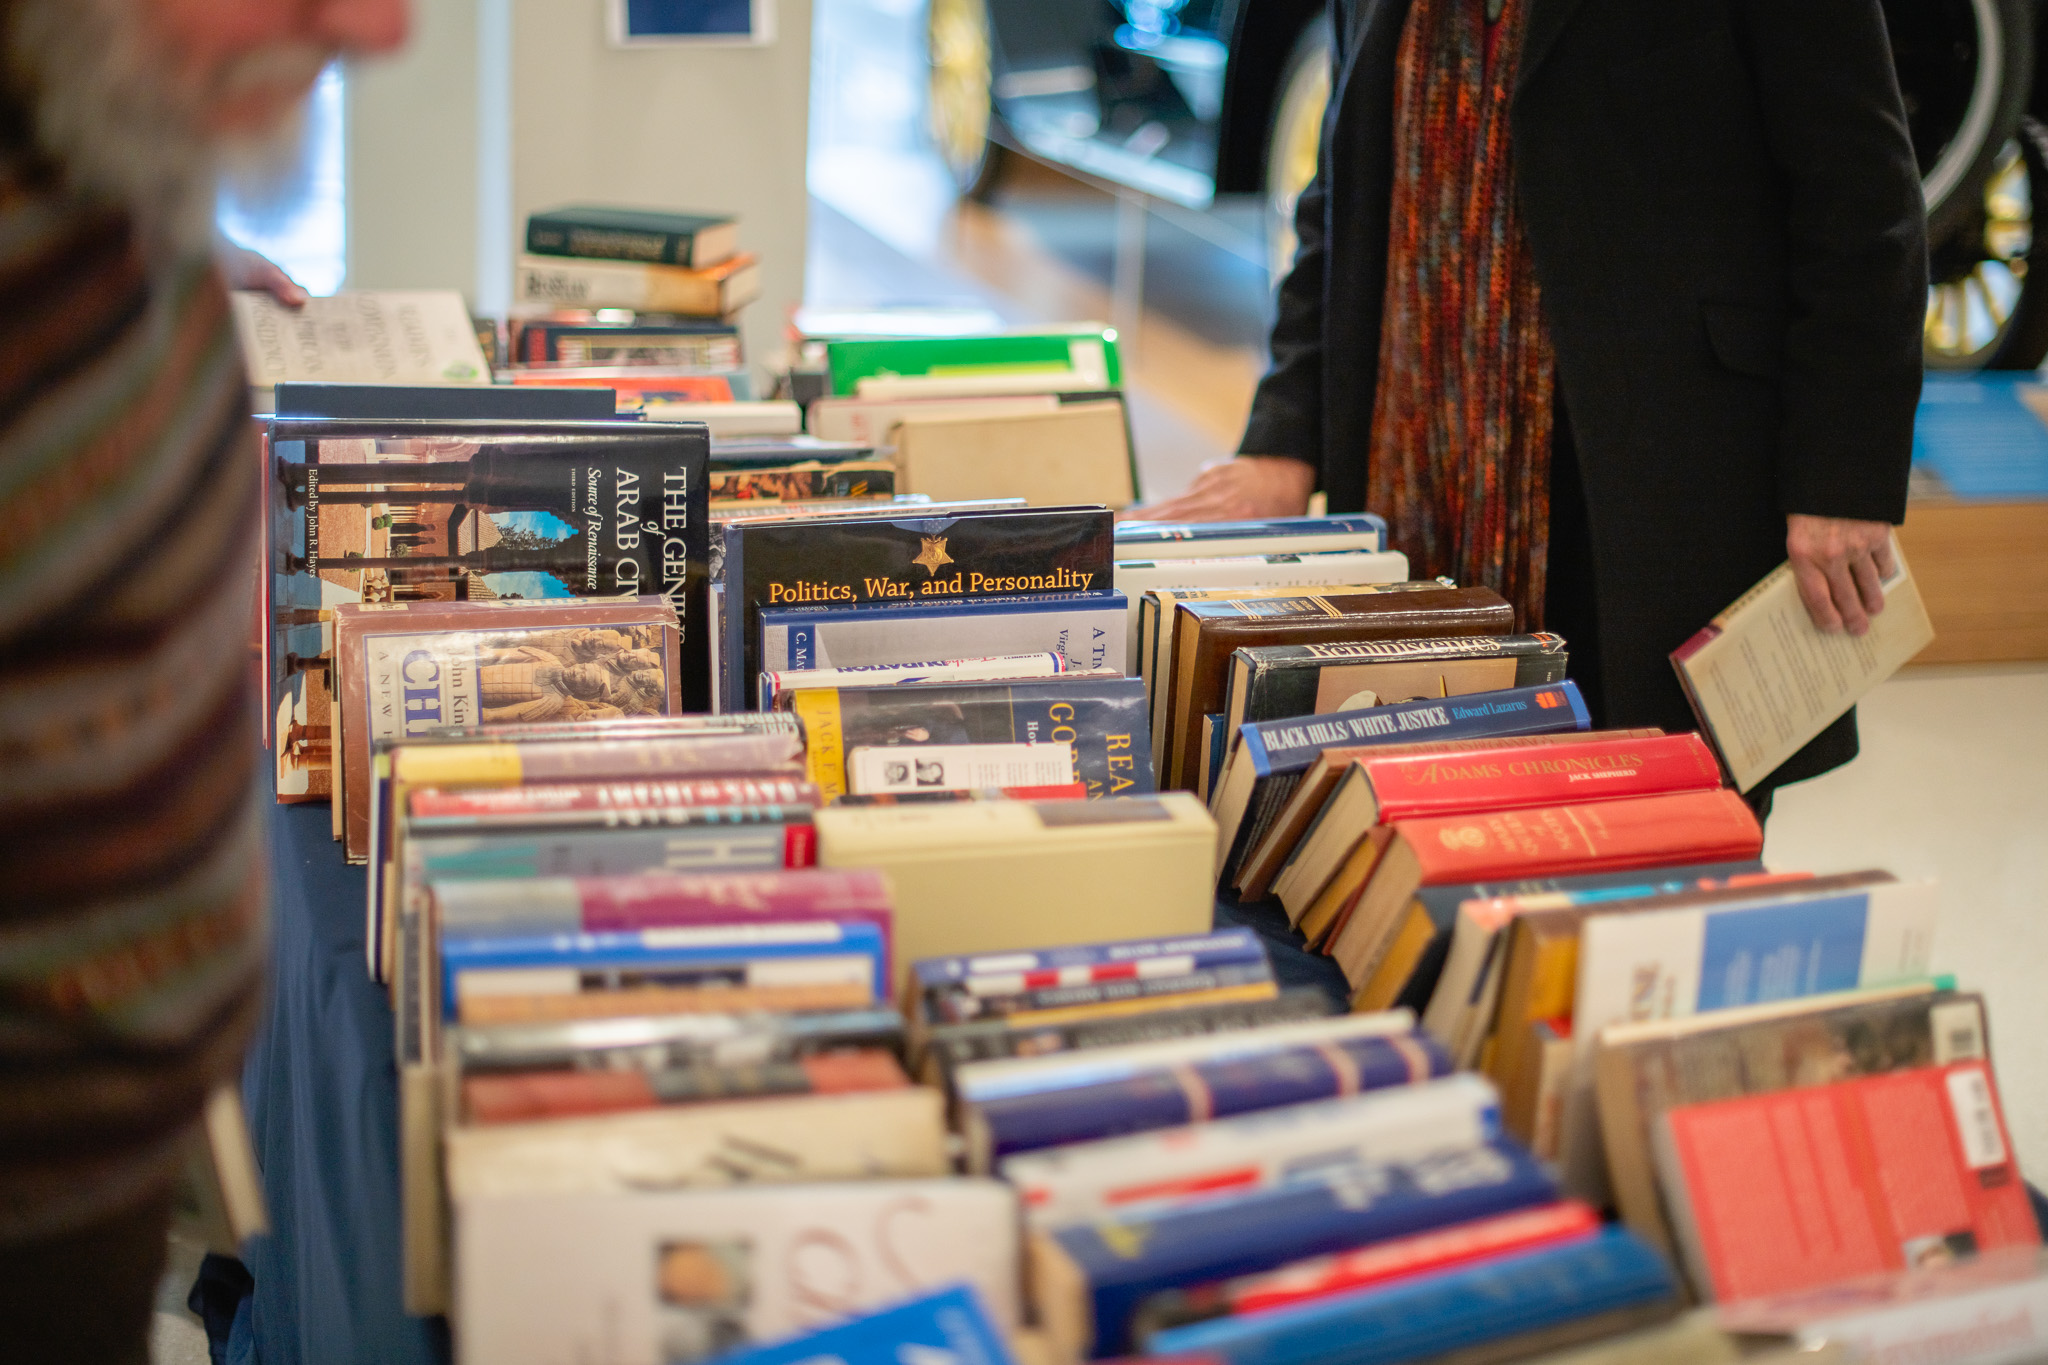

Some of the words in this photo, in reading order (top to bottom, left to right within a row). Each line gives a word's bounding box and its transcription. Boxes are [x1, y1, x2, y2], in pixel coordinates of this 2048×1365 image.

[309, 469, 319, 499] Edited
[588, 467, 602, 506] Source
[306, 501, 319, 512] by
[616, 467, 640, 550] ARAB
[663, 466, 687, 530] THE
[583, 506, 603, 520] of
[306, 514, 319, 536] John
[640, 521, 666, 540] of
[309, 539, 318, 549] R.
[588, 520, 602, 590] Renaissance
[306, 551, 318, 578] Hayes
[768, 581, 858, 603] Politics,
[864, 576, 914, 599] War,
[921, 573, 963, 595] and
[970, 568, 1093, 593] Personality
[796, 632, 807, 645] C.
[1092, 626, 1105, 640] A
[1303, 638, 1501, 659] Reminiscences
[1070, 658, 1082, 668] J.
[1451, 703, 1490, 720] Edward
[1492, 699, 1528, 714] Lazarus
[817, 710, 834, 755] JACK
[1262, 725, 1310, 752] BLACK
[1398, 706, 1450, 731] JUSTICE
[1404, 762, 1502, 785] ADAMS
[1508, 753, 1643, 777] CHRONICLES
[1568, 772, 1591, 783] JACK
[1591, 768, 1637, 780] SHEPHERD
